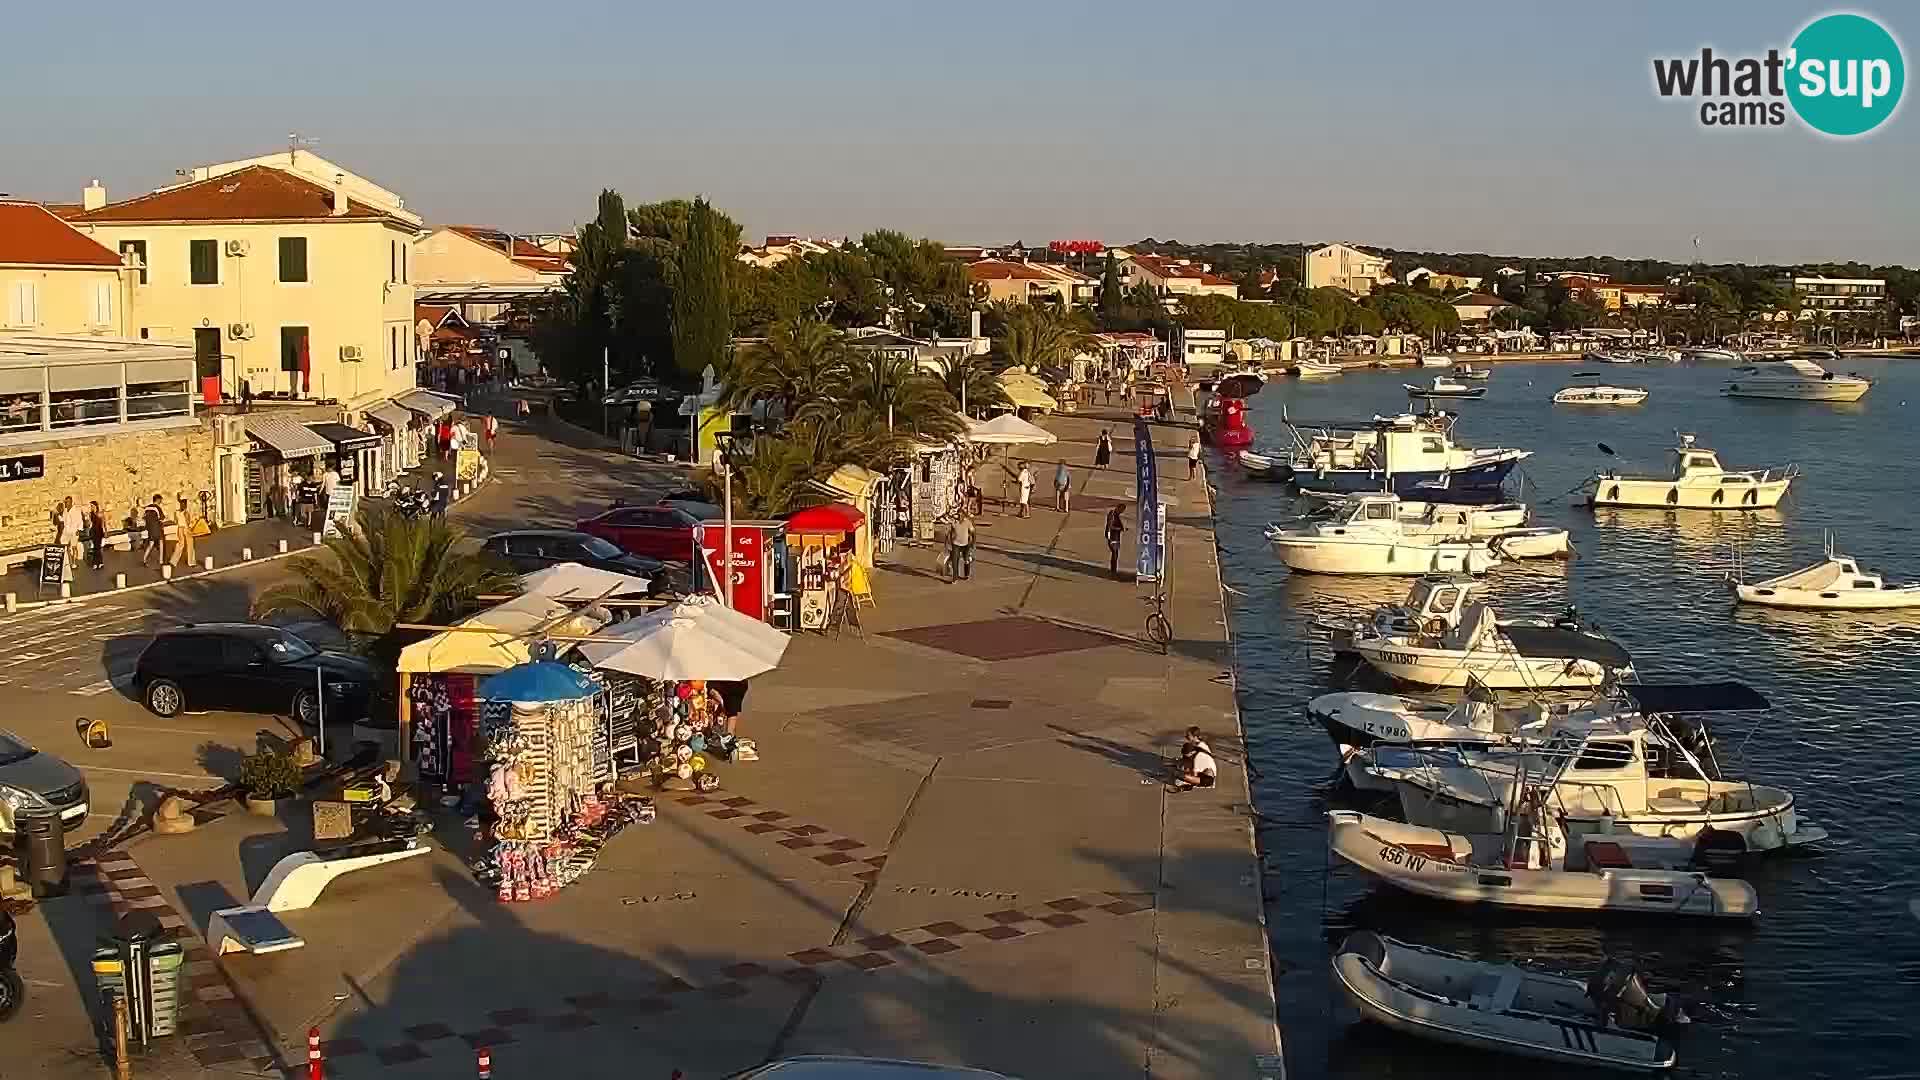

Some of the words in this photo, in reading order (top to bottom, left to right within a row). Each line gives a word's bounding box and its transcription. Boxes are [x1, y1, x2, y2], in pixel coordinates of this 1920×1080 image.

[1363, 722, 1375, 732] IZ
[1379, 725, 1407, 737] 1980
[1379, 846, 1406, 865] 456
[1405, 855, 1427, 873] NV
